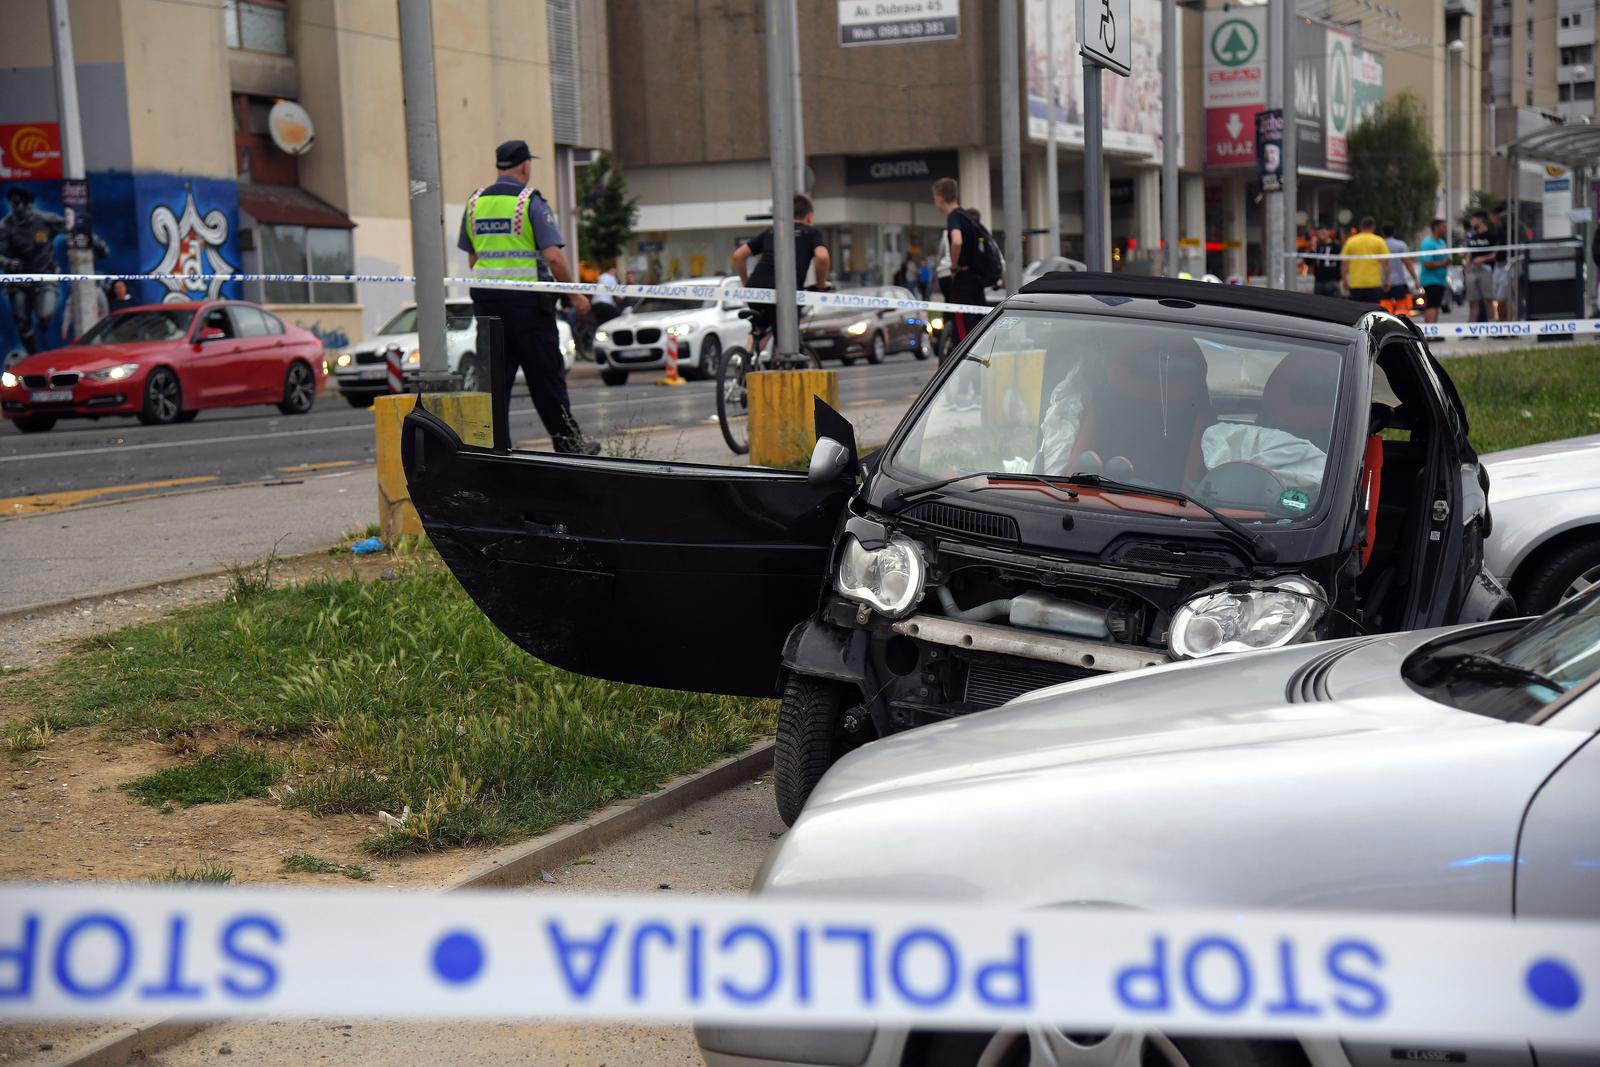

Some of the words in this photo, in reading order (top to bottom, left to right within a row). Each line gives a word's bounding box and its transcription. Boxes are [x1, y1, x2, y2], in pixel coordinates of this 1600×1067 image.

[875, 3, 923, 16] Dubrava
[869, 160, 930, 178] CENTRA
[1468, 323, 1531, 335] POLICIJA
[1540, 322, 1577, 333] STOP
[544, 916, 1034, 1010] POLICIJA
[1111, 930, 1390, 1021] STOP
[1407, 1048, 1448, 1061] CLASSIC
